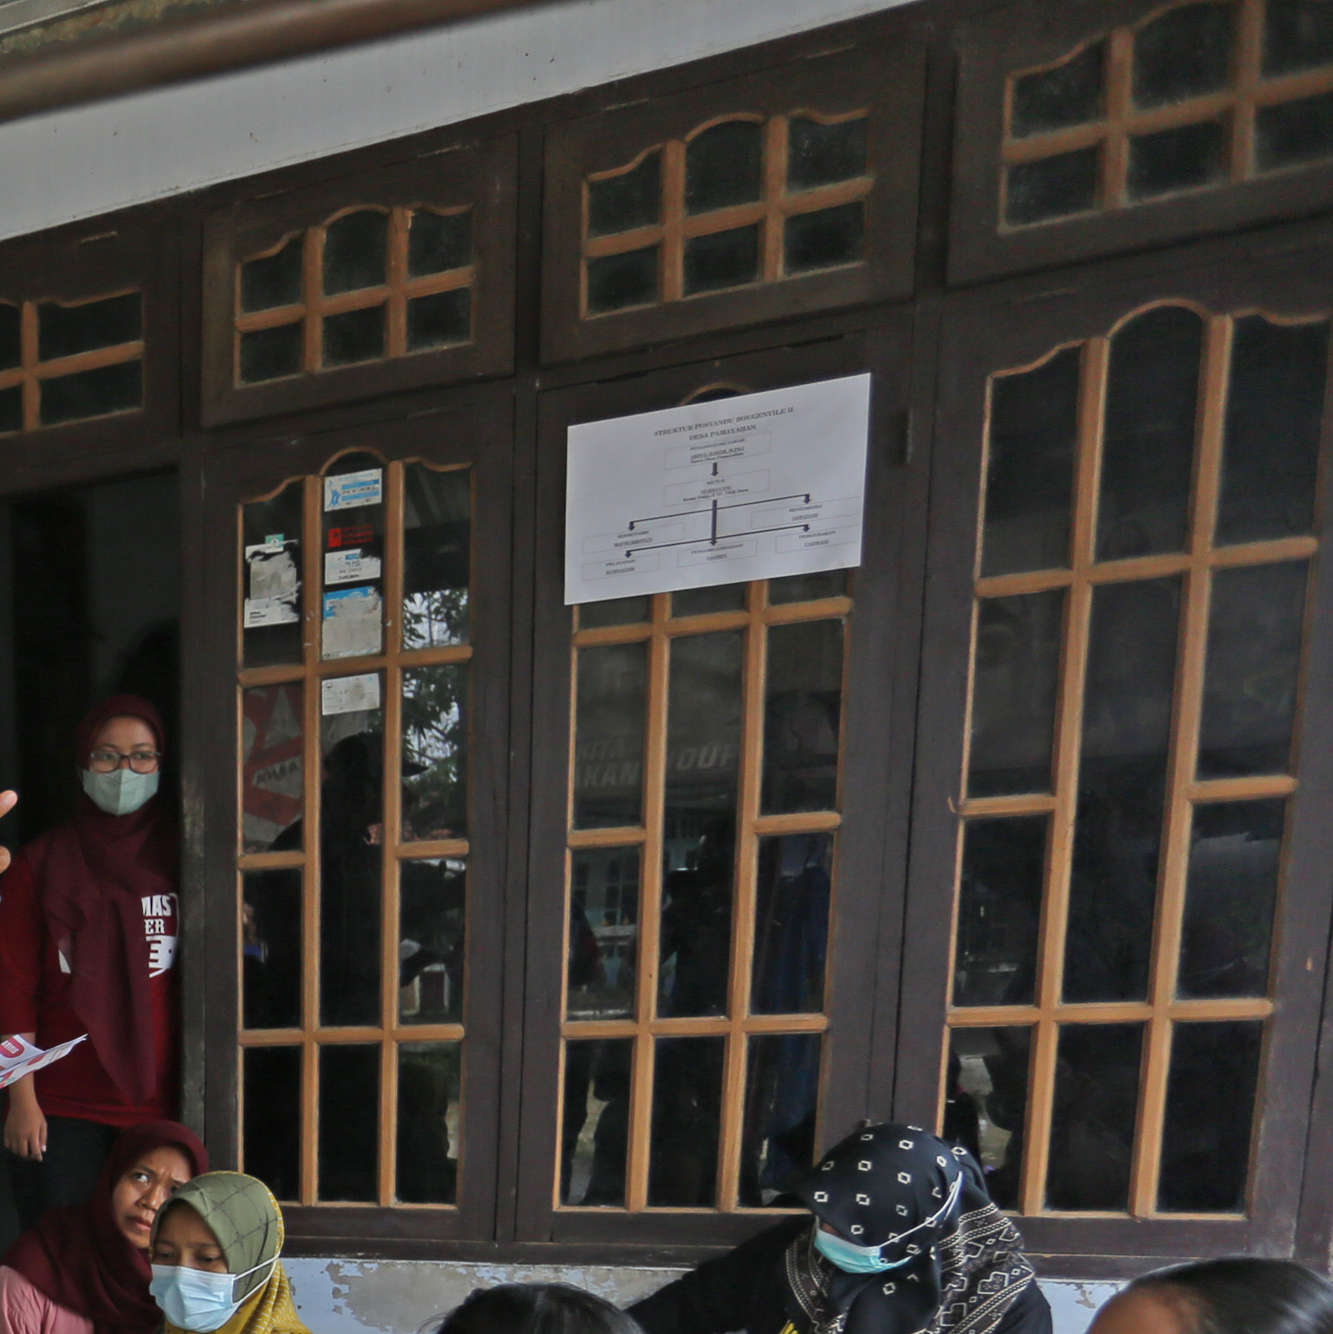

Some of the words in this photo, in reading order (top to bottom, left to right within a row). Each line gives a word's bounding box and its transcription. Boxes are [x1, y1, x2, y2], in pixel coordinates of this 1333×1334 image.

[653, 424, 694, 438] STRUKTUR
[695, 416, 735, 431] POSYANDU
[689, 432, 709, 442] DESA
